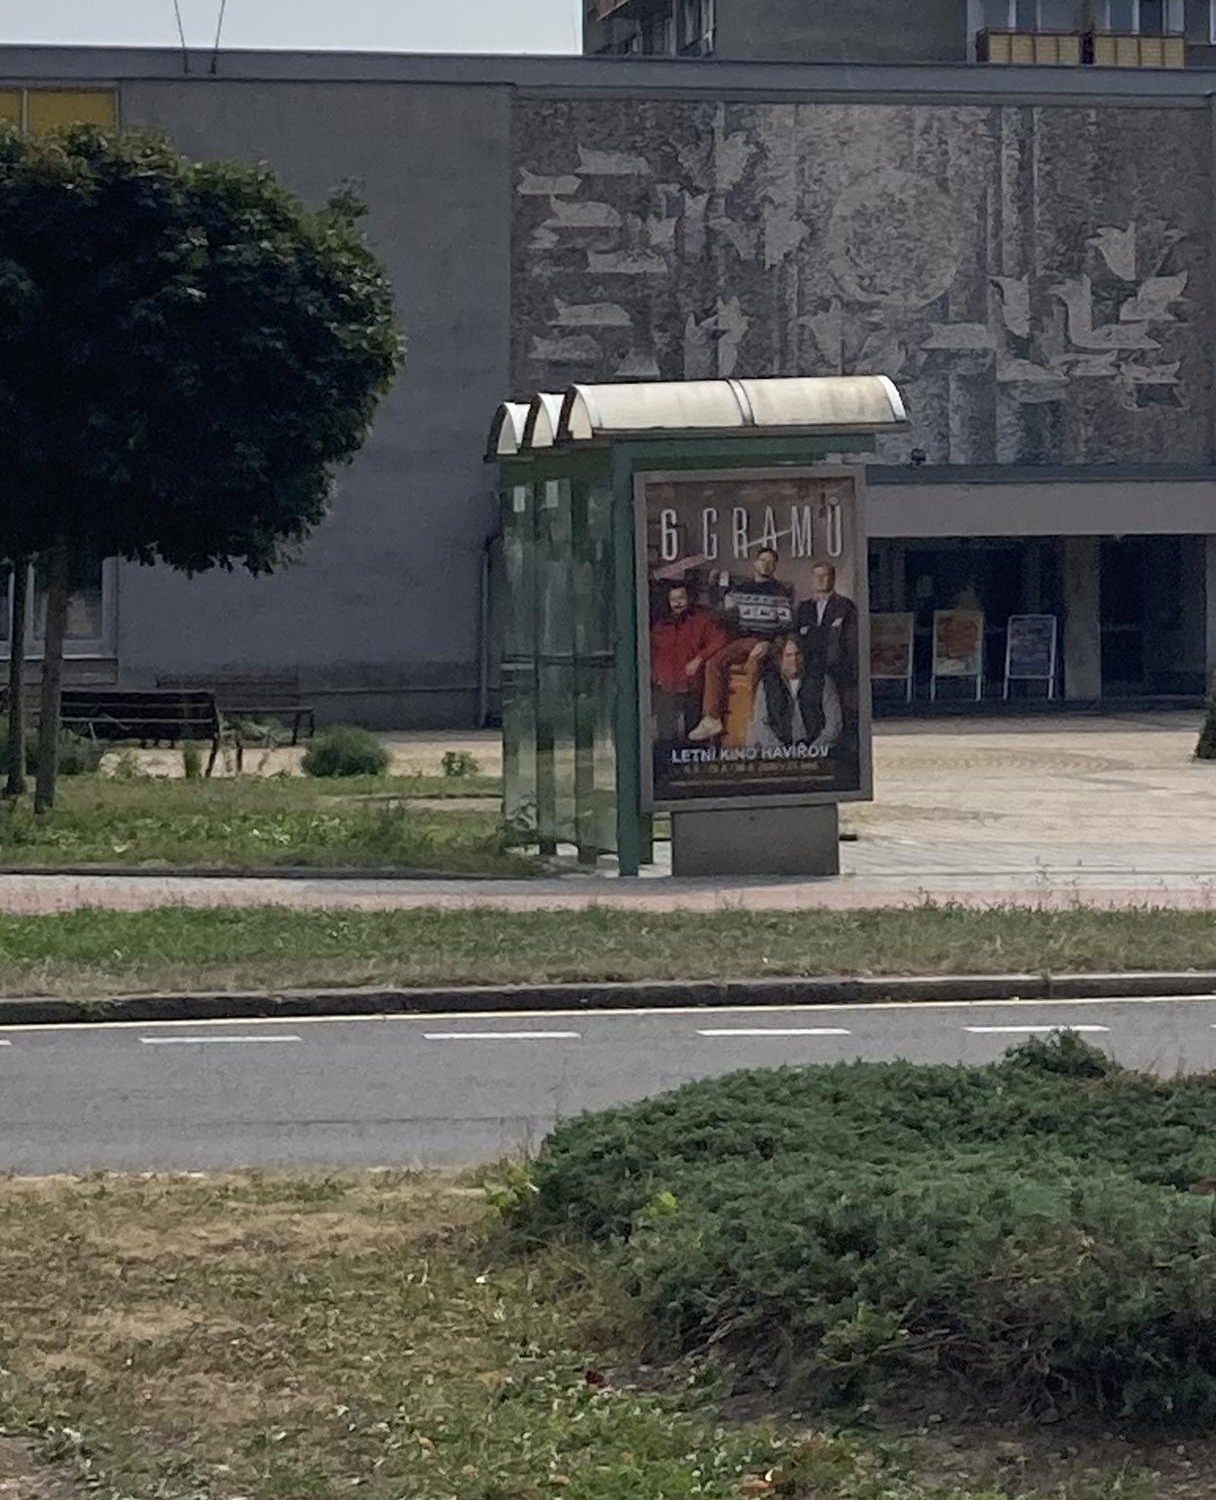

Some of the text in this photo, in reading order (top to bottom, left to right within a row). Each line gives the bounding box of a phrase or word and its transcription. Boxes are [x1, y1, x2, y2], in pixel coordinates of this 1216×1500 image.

[660, 497, 842, 561] 6 GRAMŮ
[671, 745, 716, 764] LETNÍ
